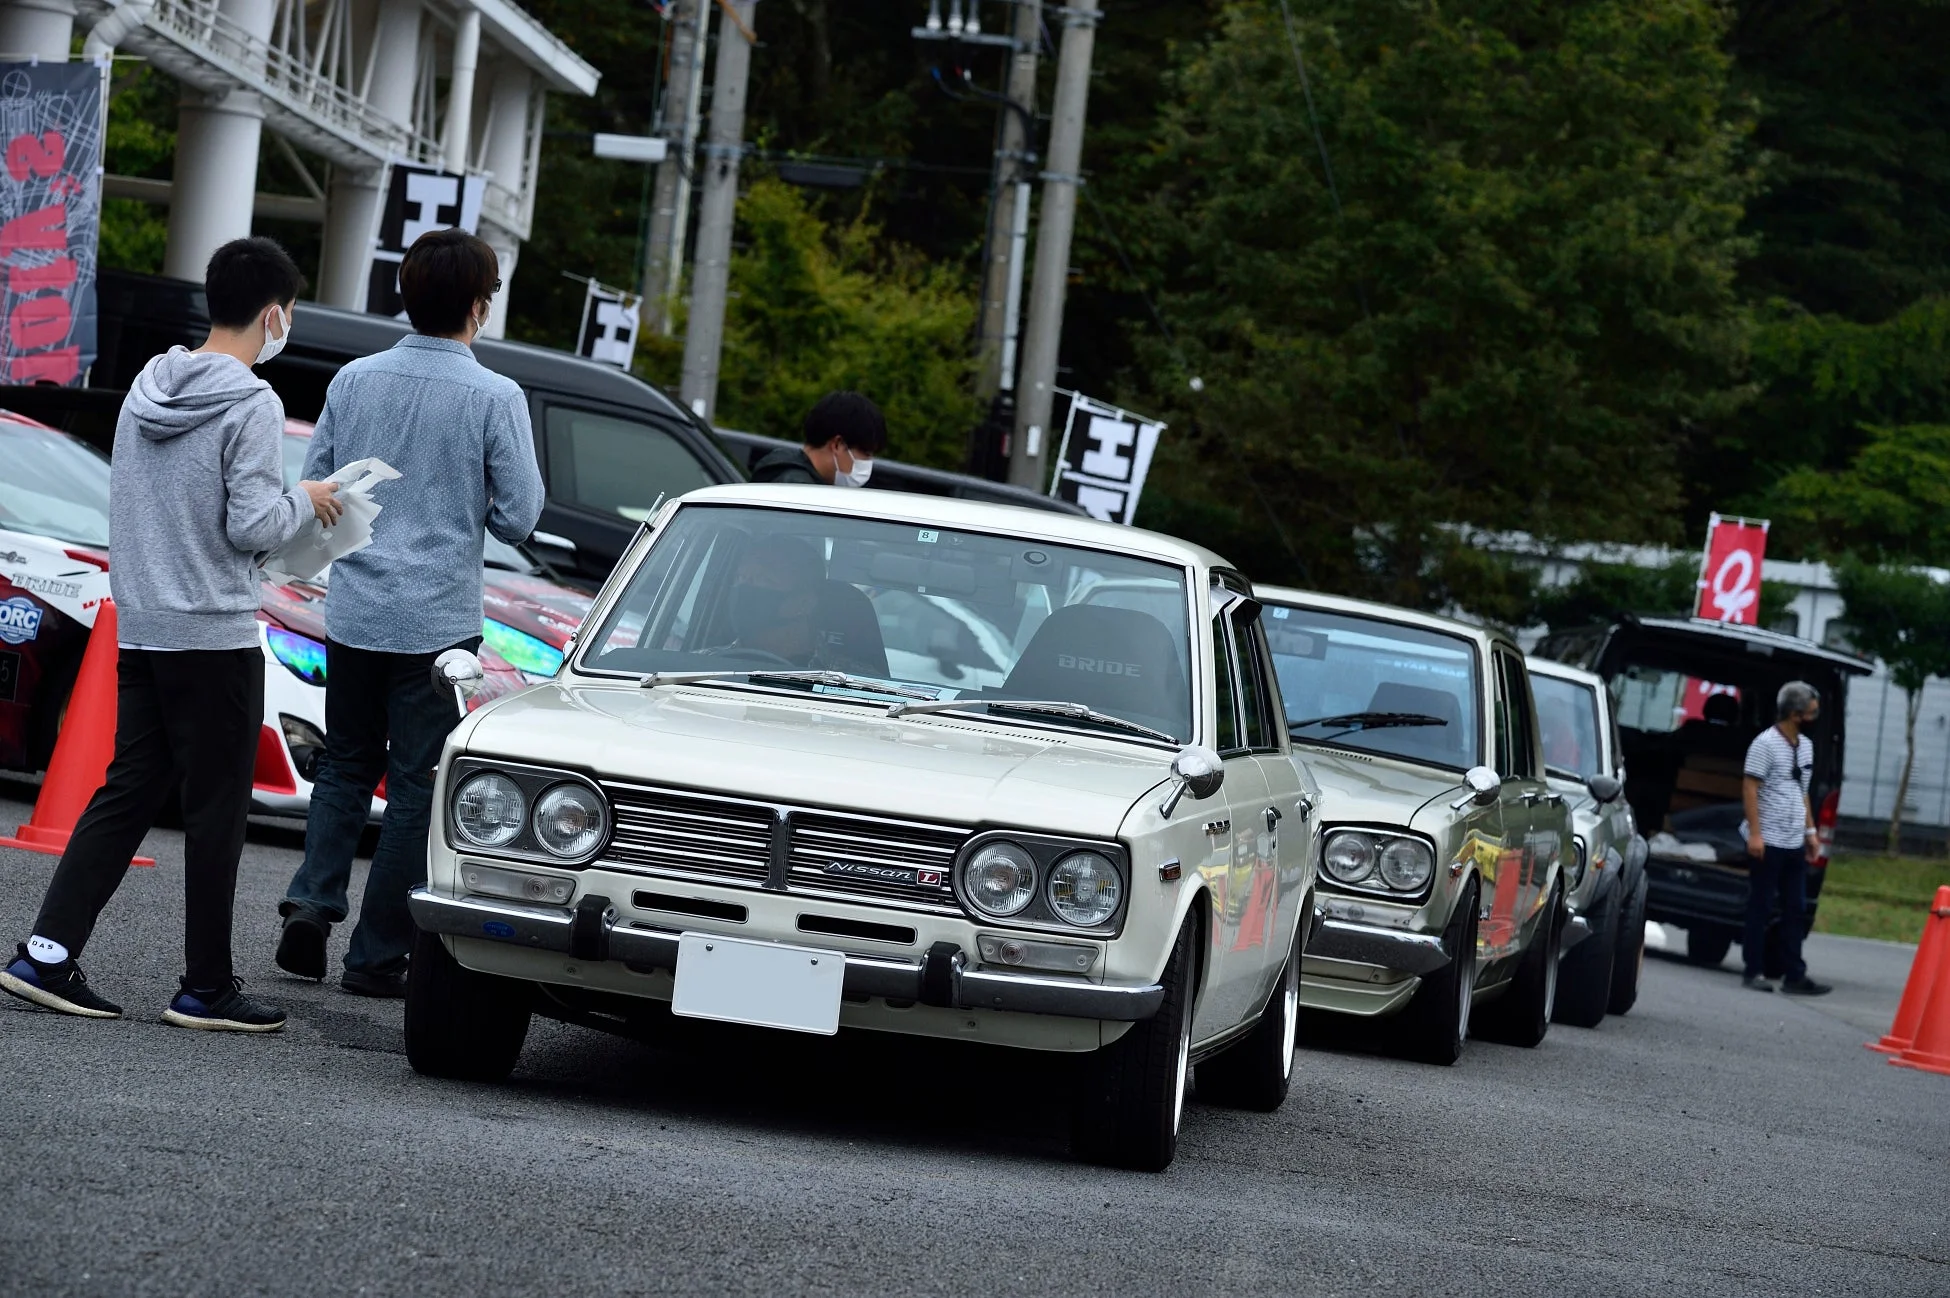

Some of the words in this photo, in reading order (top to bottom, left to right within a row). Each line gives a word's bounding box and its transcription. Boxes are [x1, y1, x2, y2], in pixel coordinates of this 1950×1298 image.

[11, 573, 82, 598] BRIDE
[1058, 654, 1142, 677] BRIDE
[828, 861, 911, 879] Nissan
[920, 872, 938, 884] L
